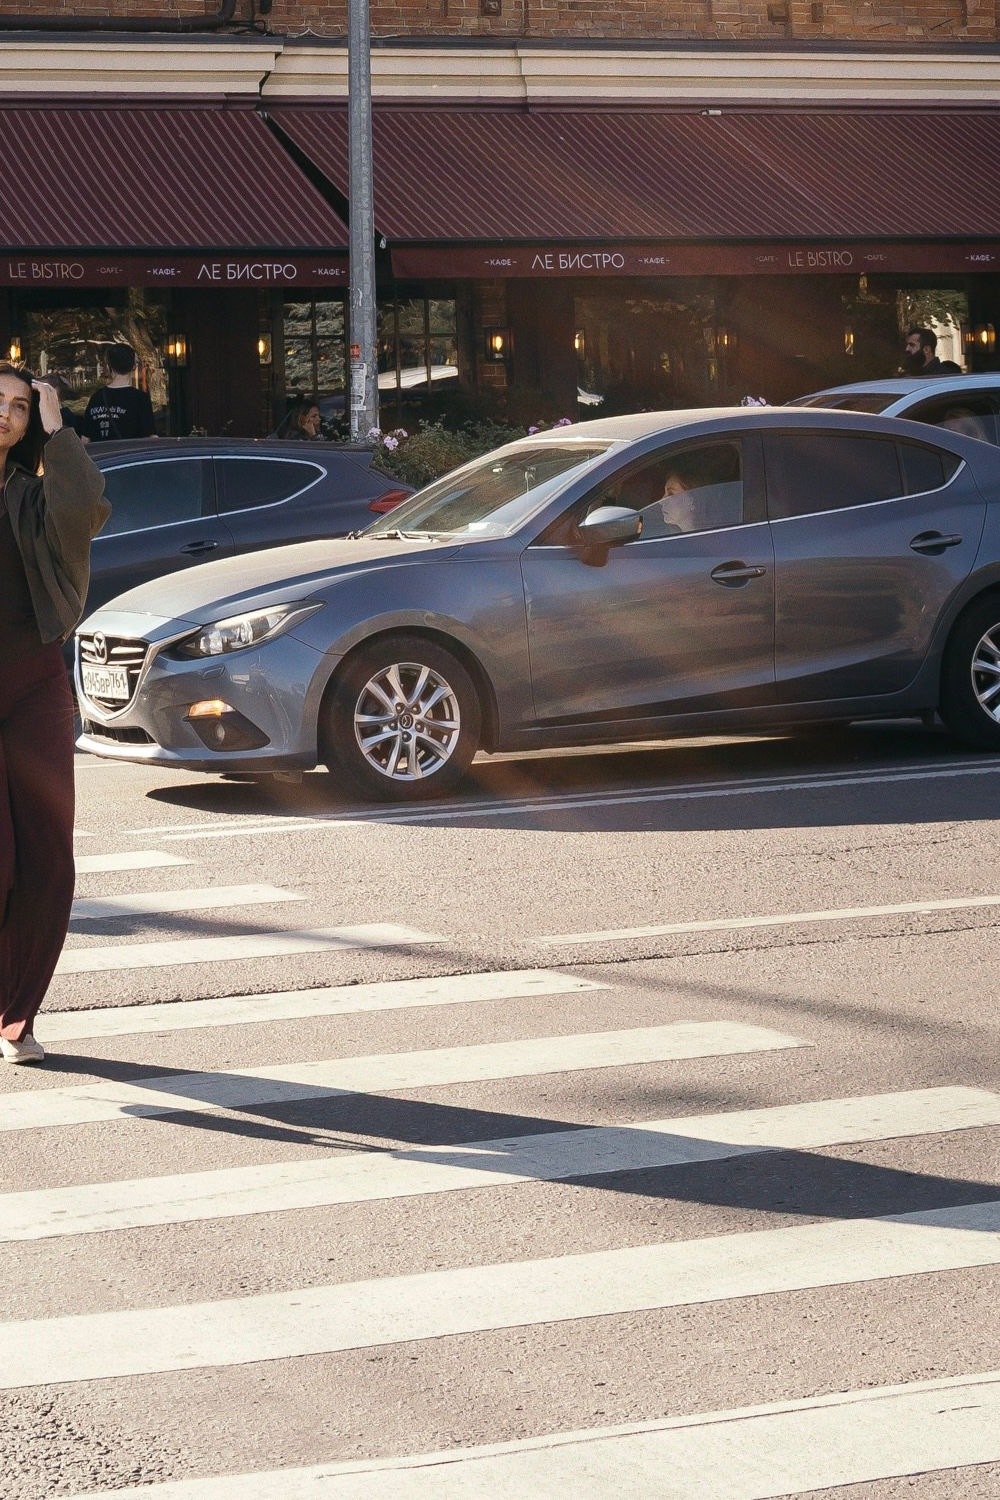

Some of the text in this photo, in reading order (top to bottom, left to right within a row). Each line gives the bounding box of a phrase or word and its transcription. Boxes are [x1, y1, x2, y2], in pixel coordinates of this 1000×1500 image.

[531, 254, 554, 269] ЛЕ
[558, 253, 625, 269] БИСТРО
[788, 251, 803, 267] LE
[807, 251, 853, 267] BISTRO
[8, 262, 27, 279] LE
[31, 262, 85, 279] BISTRO
[197, 263, 221, 280] ЛЕ
[226, 263, 297, 280] БИСТРО
